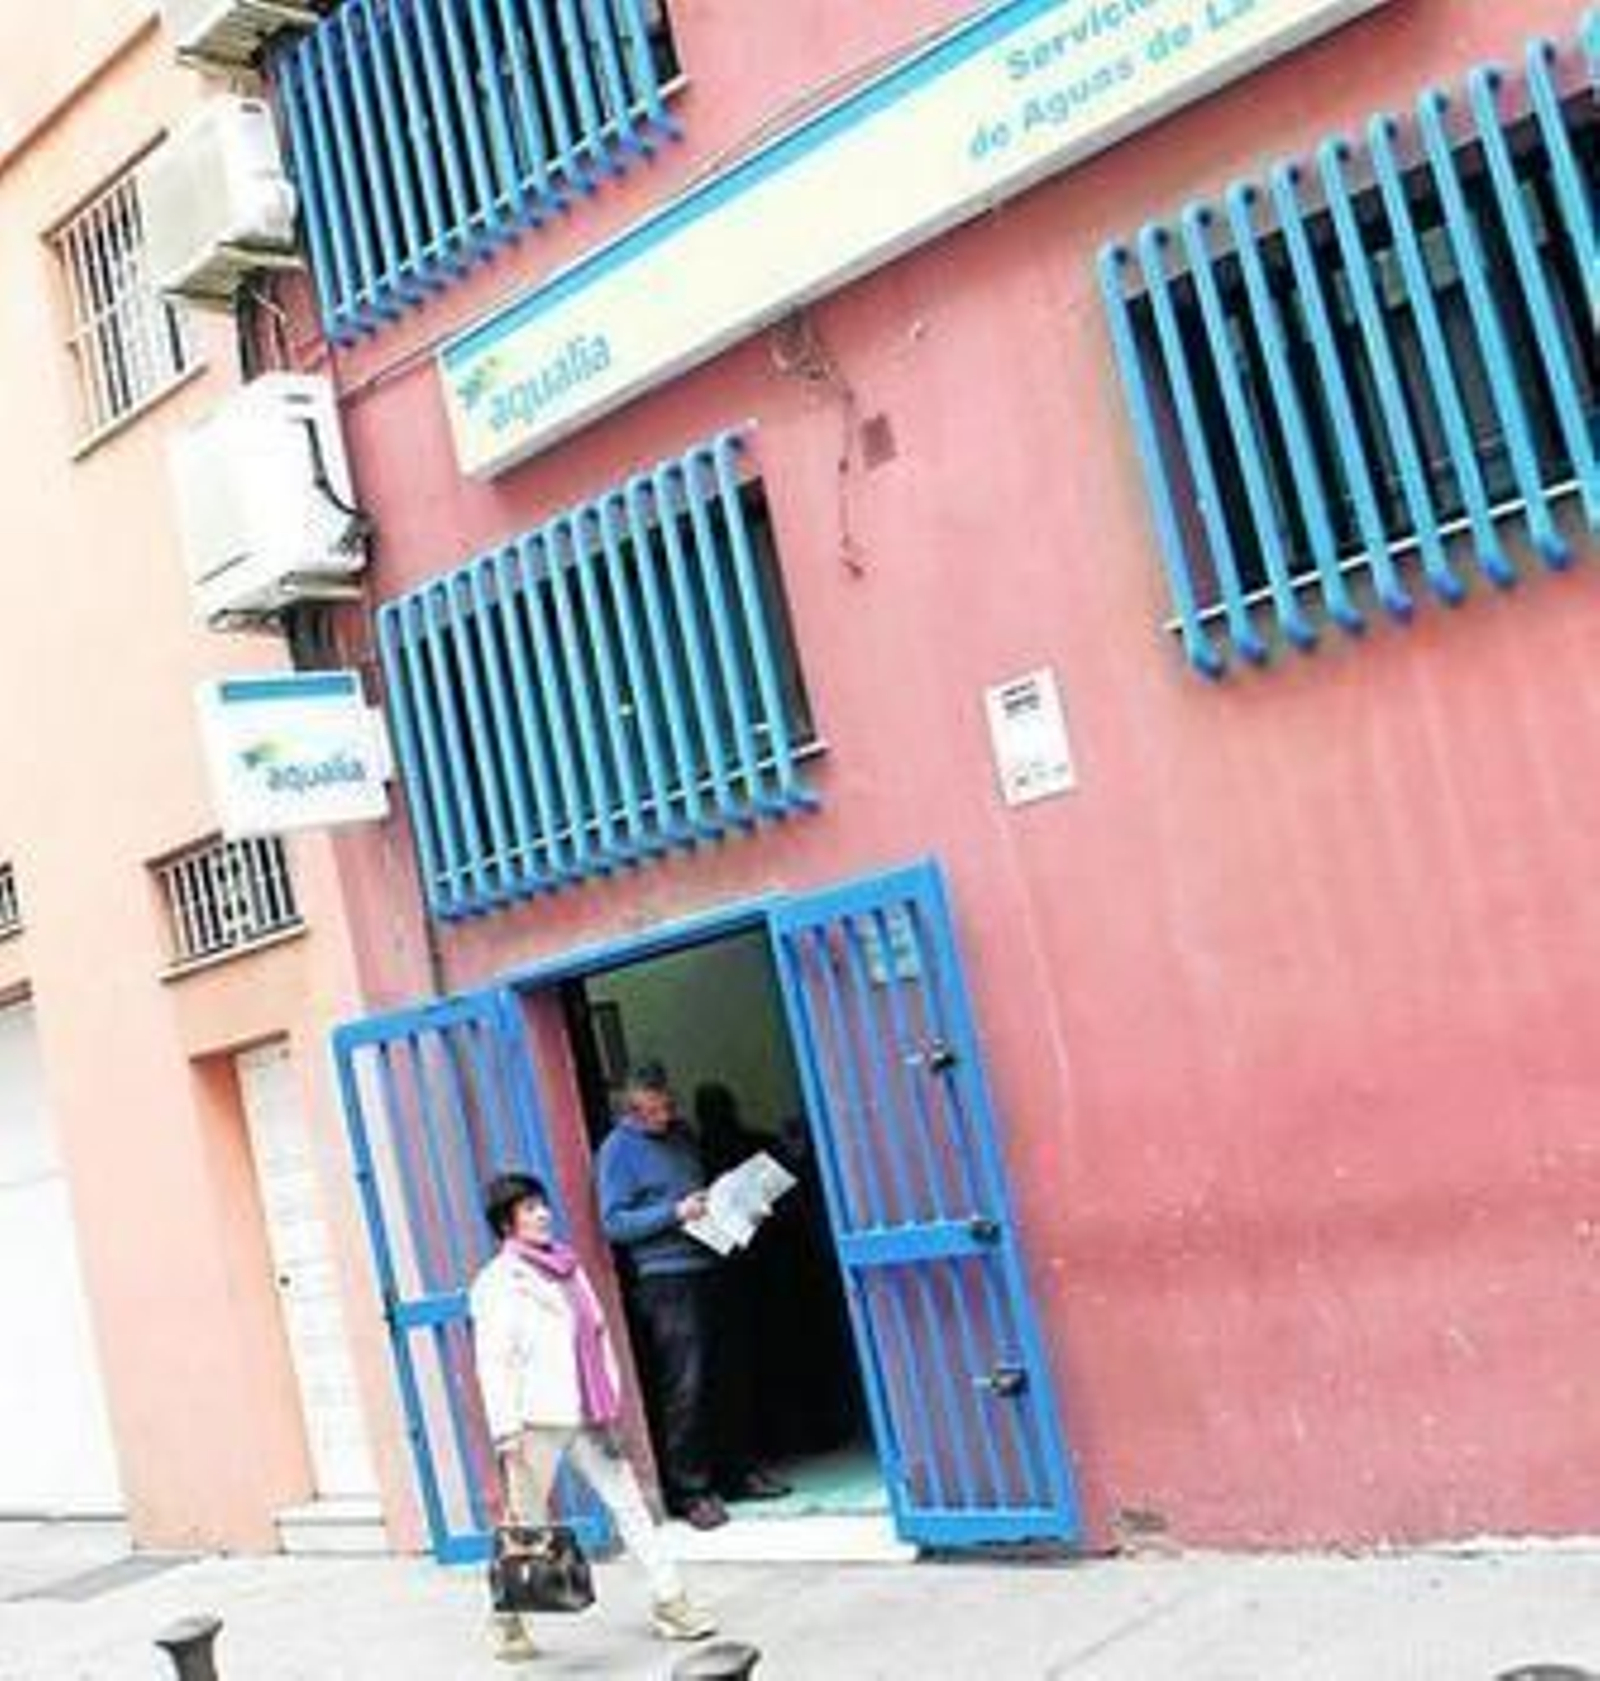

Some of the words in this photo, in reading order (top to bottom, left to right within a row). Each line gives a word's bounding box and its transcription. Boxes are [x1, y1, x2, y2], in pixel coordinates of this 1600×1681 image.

[970, 122, 1010, 158] de
[1024, 56, 1135, 131] Aguas
[1146, 23, 1192, 62] de
[489, 333, 611, 432] aqualia
[265, 755, 367, 793] aqualia
